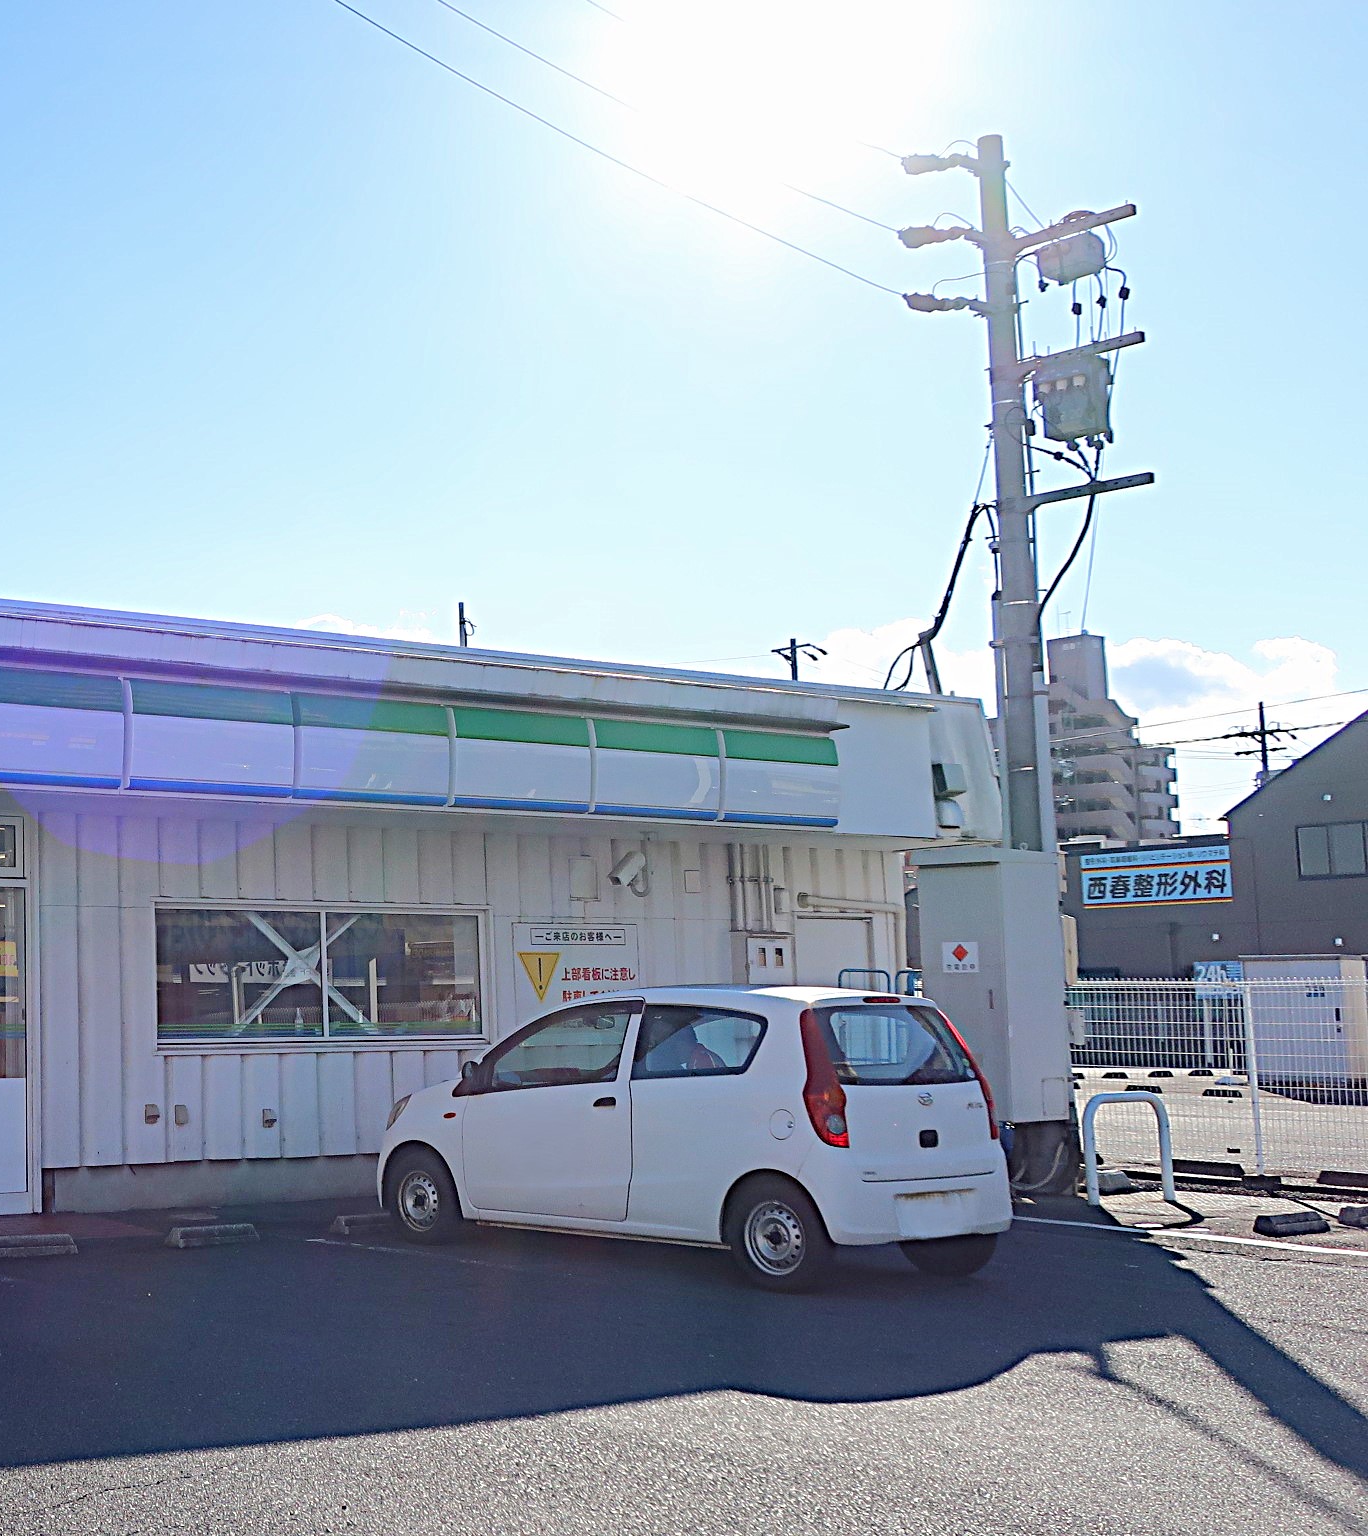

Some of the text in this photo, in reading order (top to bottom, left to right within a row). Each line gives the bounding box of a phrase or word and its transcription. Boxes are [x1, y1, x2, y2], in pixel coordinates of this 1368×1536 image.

[1087, 868, 1228, 900] 西春整形外科
[561, 967, 636, 981] 上部看板に注意し
